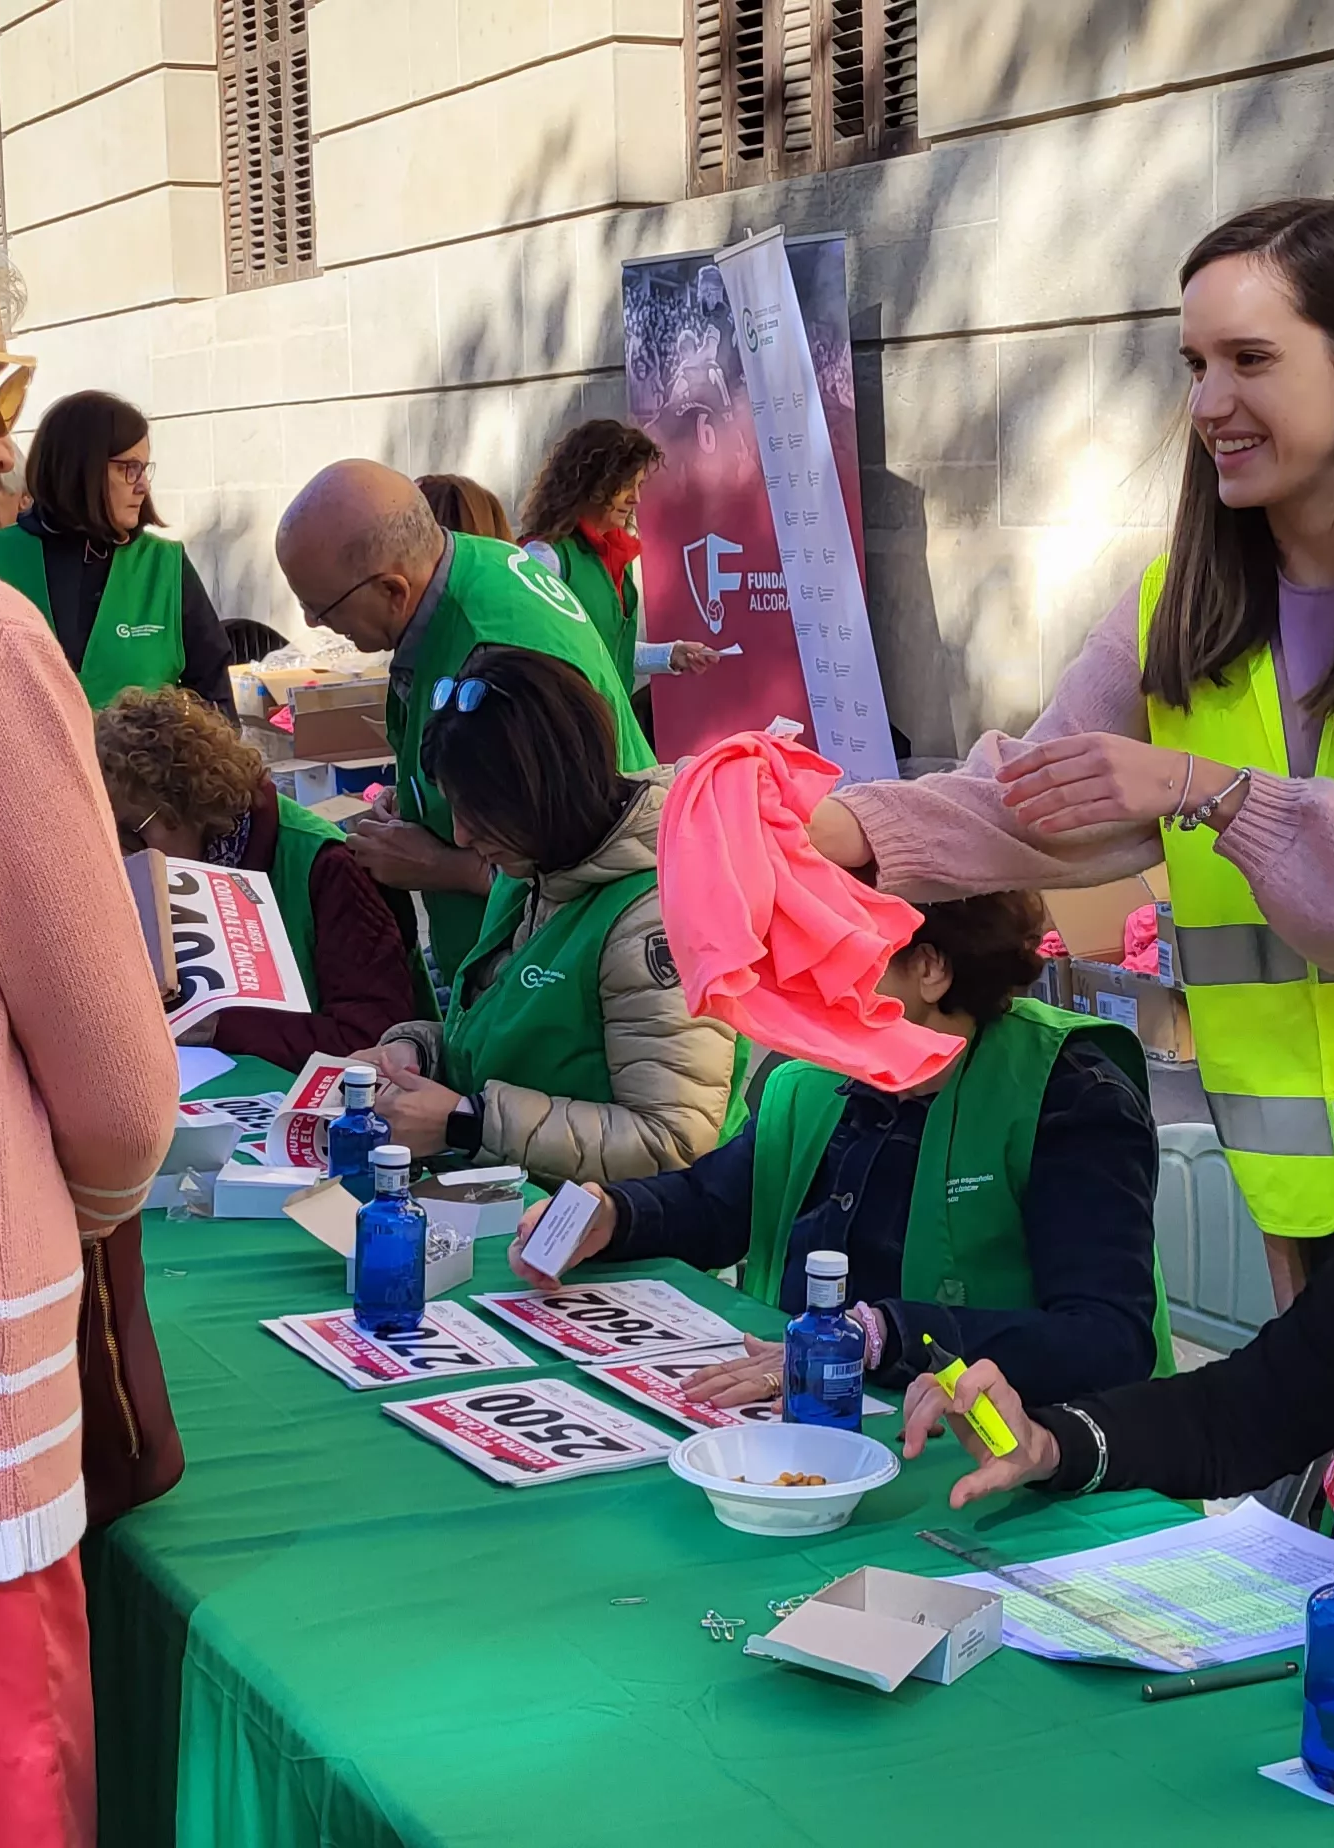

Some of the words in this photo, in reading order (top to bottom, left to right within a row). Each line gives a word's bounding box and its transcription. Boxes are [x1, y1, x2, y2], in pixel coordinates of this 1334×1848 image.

[212, 878, 242, 926] CONTRA
[226, 925, 246, 943] EL
[291, 1114, 305, 1155] HUESCA
[301, 1130, 312, 1147] EL
[543, 1292, 685, 1346] 2602
[325, 1320, 359, 1347] CÁNCER
[566, 1323, 613, 1351] CONTRA
[366, 1348, 404, 1376] CONTRA
[432, 1402, 489, 1435] CÁNCER
[466, 1393, 632, 1459] 2500
[481, 1424, 502, 1441] EL
[456, 1427, 494, 1448] HUESCA
[497, 1435, 551, 1465] CONTRA
